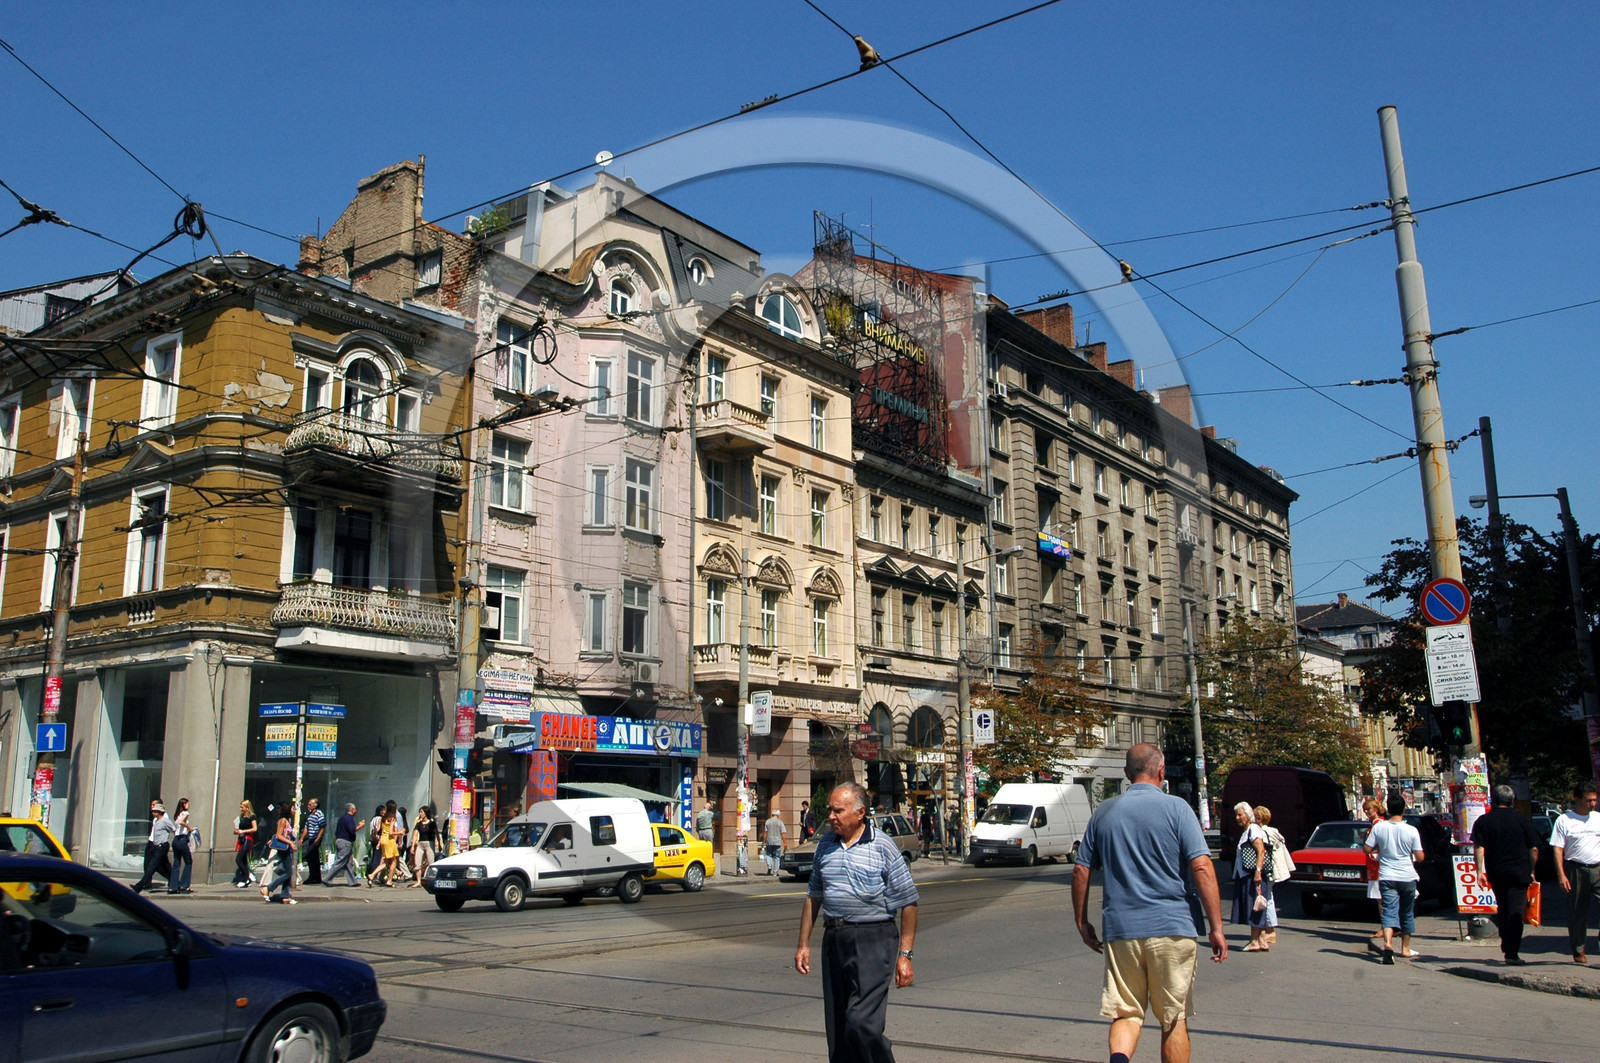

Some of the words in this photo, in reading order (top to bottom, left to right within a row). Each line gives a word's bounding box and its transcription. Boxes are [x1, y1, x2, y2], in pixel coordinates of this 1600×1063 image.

[864, 320, 926, 365] ВНИМАНИЕ!
[875, 386, 928, 424] ПРЕМИНИ
[478, 670, 500, 678] EGIMA
[508, 671, 533, 682] НЕГИМА
[541, 712, 598, 739] CHANGE
[553, 740, 595, 749] COMMISSION
[542, 752, 555, 801] CHAN
[1457, 861, 1478, 906] ФОТО
